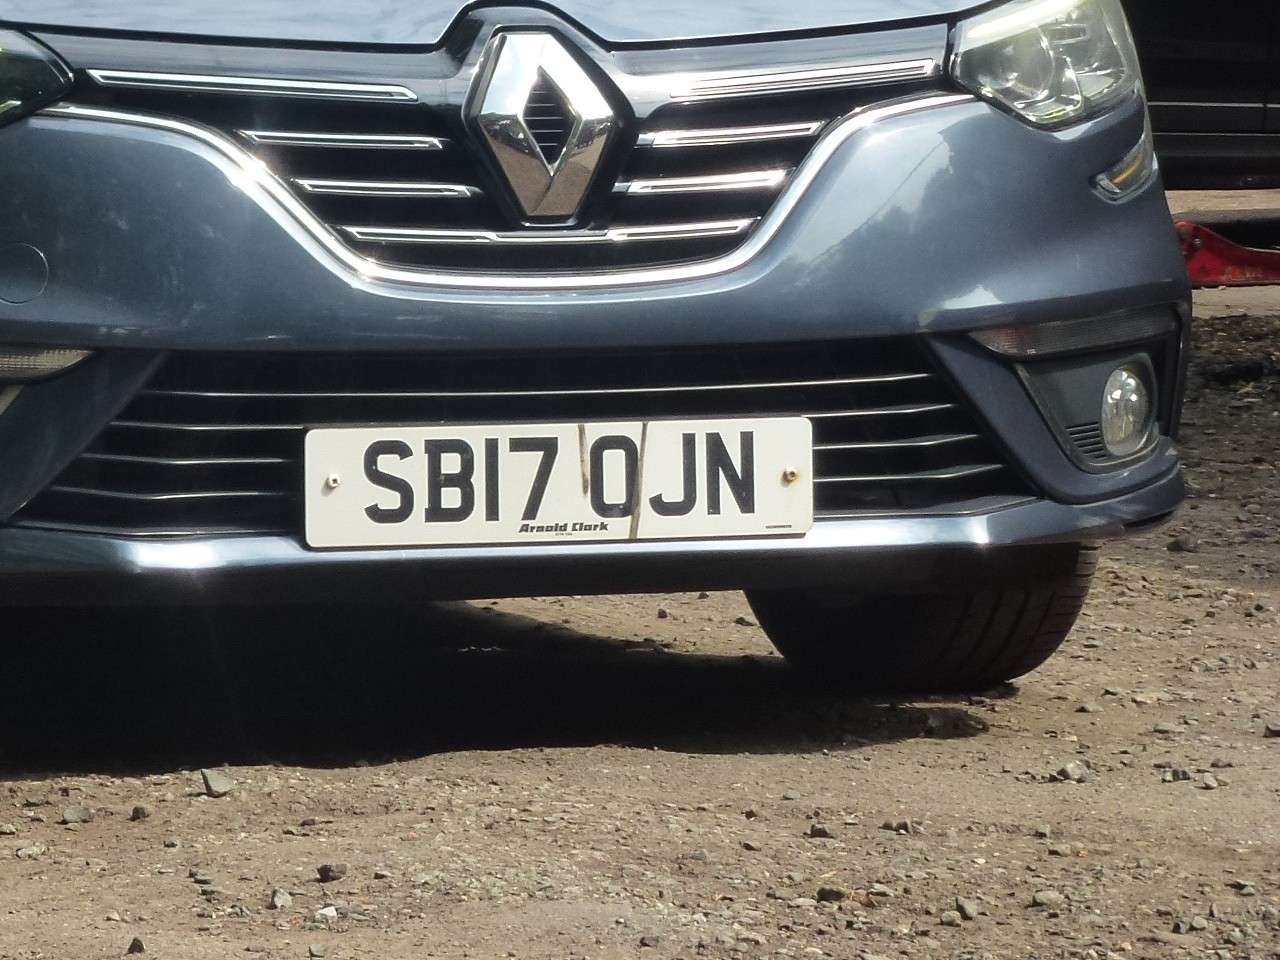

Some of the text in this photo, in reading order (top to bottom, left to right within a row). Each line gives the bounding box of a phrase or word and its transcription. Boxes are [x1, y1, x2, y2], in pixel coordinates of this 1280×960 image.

[362, 430, 755, 524] SB17 OJN
[518, 521, 609, 534] Arnold Clark
